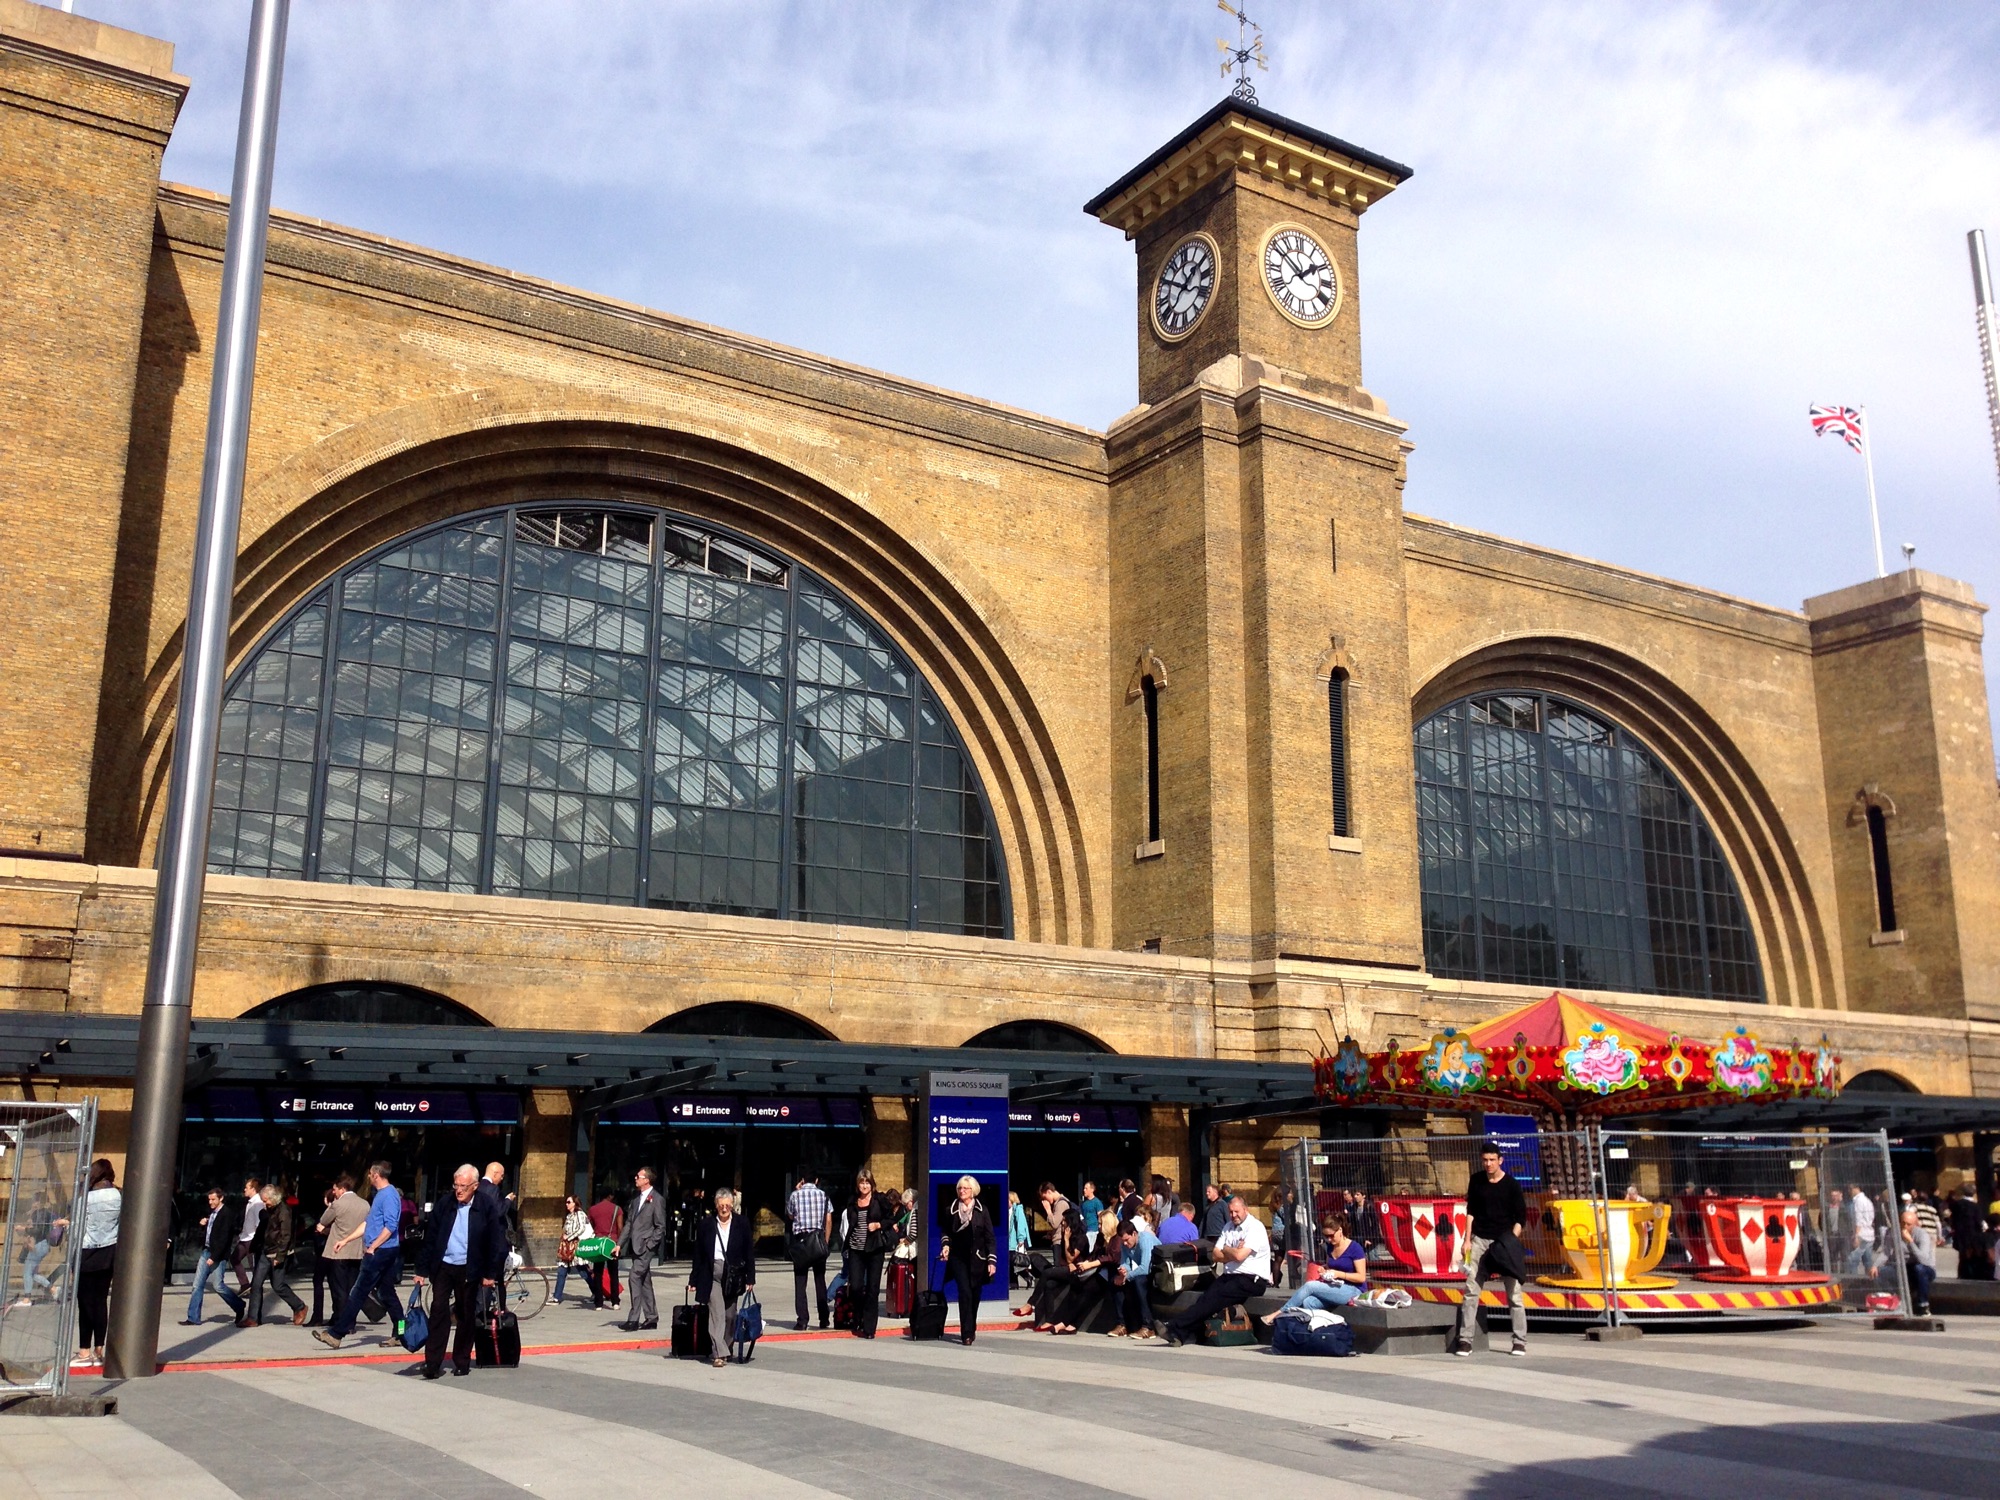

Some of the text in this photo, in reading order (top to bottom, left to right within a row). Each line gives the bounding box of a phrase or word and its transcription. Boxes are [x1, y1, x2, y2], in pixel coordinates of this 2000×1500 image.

[957, 1081, 978, 1089] CROSS
[979, 1082, 1003, 1090] SQUARE
[310, 1100, 416, 1113] Entrance No entry
[695, 1105, 779, 1117] Entrance No entry
[948, 1116, 966, 1124] Station
[1009, 1113, 1072, 1123] ntrance No entry
[948, 1127, 980, 1135] Underground
[318, 1143, 327, 1155] 7
[719, 1144, 726, 1155] 5
